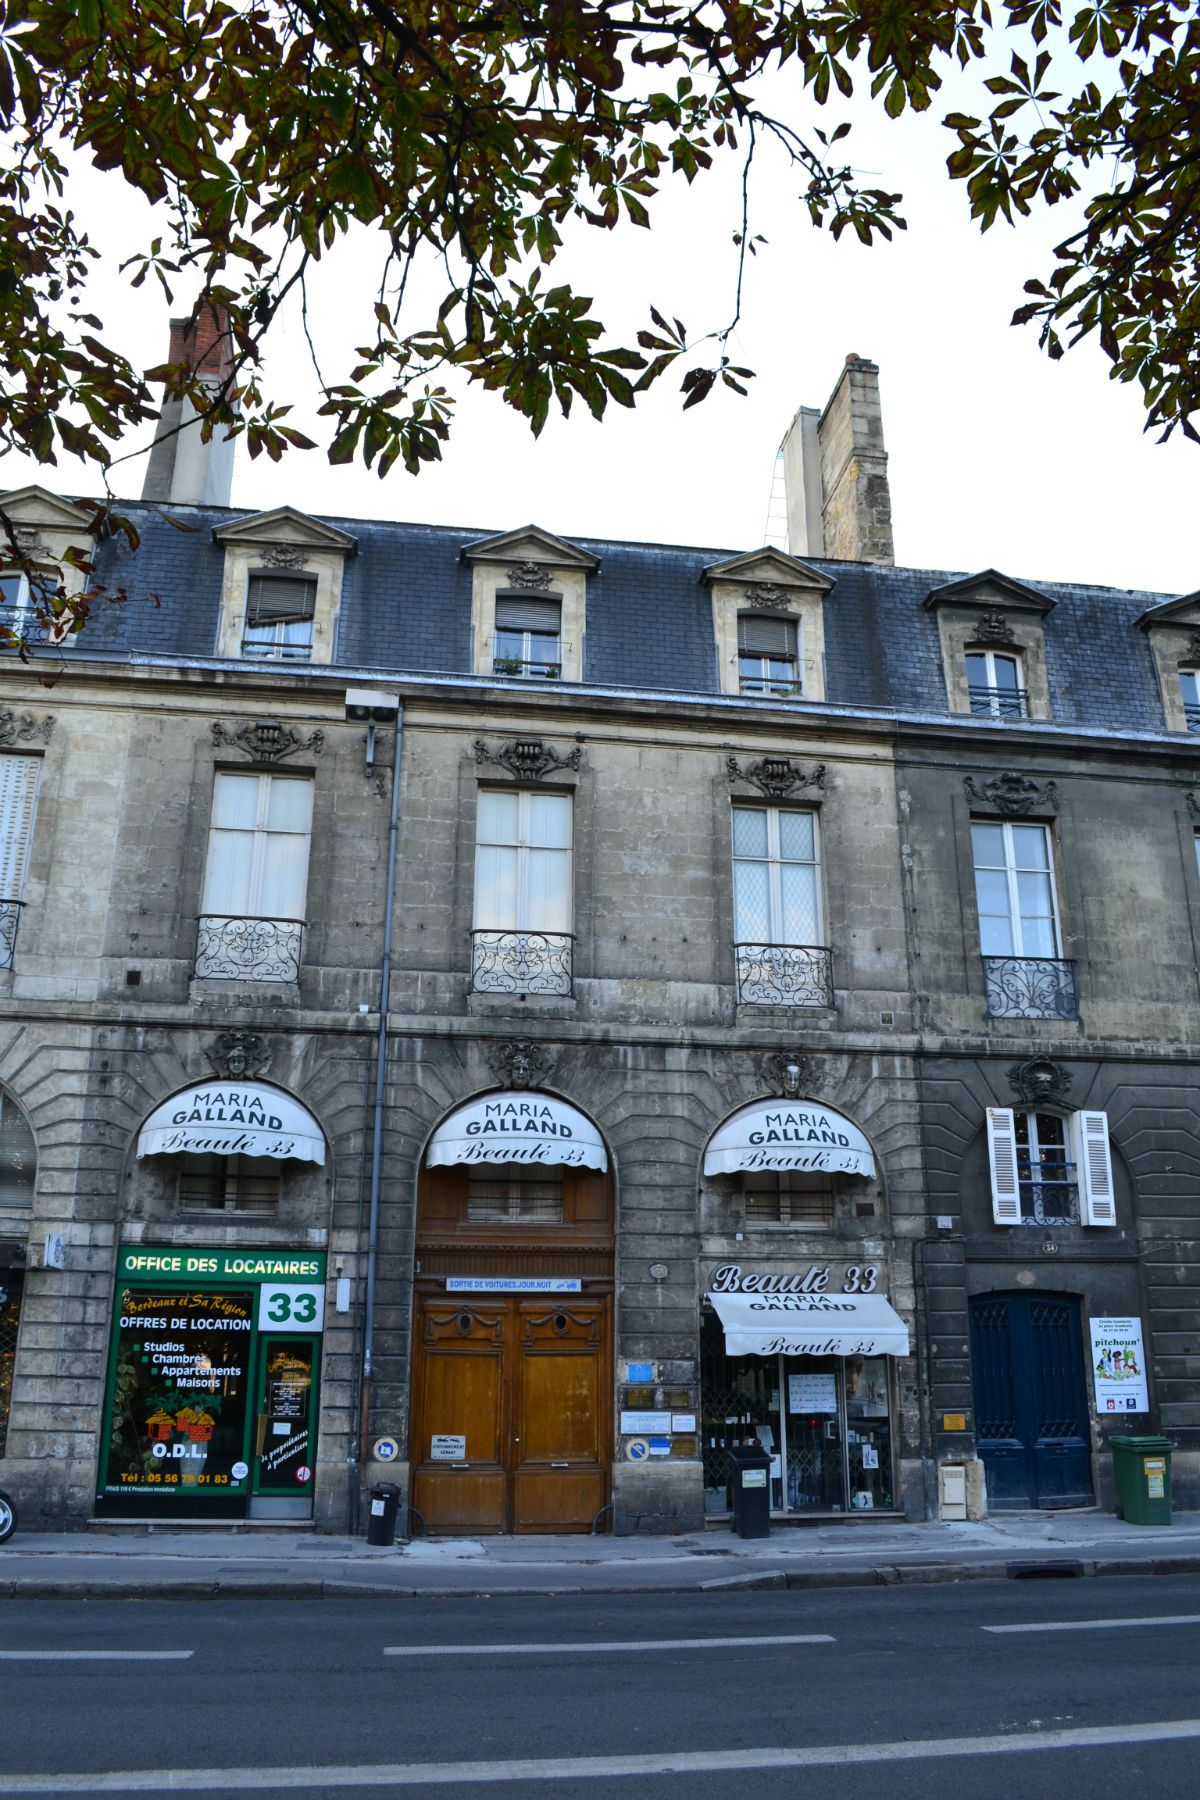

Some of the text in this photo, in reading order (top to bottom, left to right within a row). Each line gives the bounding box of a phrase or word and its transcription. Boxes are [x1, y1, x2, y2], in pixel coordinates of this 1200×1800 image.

[193, 1093, 264, 1110] MARIA
[172, 1108, 283, 1130] GALLAND
[485, 1103, 553, 1120] MARIA
[465, 1118, 573, 1138] GALLAND
[765, 1113, 832, 1129] MARIA
[162, 1130, 295, 1155] Beauté 33
[748, 1128, 849, 1147] GALLAND
[456, 1141, 585, 1163] Beauté 33
[740, 1149, 860, 1170] Beauté 33
[125, 1256, 319, 1275] OFFICE DES LOCATAIRES
[449, 1280, 473, 1288] SORTIE
[712, 1264, 878, 1293] Beauté 33
[126, 1294, 247, 1317] Bordeaux et Sa Région
[749, 1303, 857, 1312] GALLAND
[763, 1295, 832, 1303] MARIA
[267, 1293, 317, 1323] 33
[120, 1316, 251, 1331] OFFRES DE LOCATION
[143, 1342, 185, 1352] Studios
[762, 1336, 875, 1353] Beauté 33
[152, 1354, 207, 1364] Chambres
[161, 1366, 241, 1377] Appartements
[177, 1378, 221, 1388] Maisons
[152, 1443, 208, 1459] O.D.L.
[147, 1474, 162, 1483] 05
[164, 1474, 178, 1483] 56
[181, 1474, 195, 1483] 79
[197, 1474, 210, 1483] 01
[214, 1474, 228, 1484] 83
